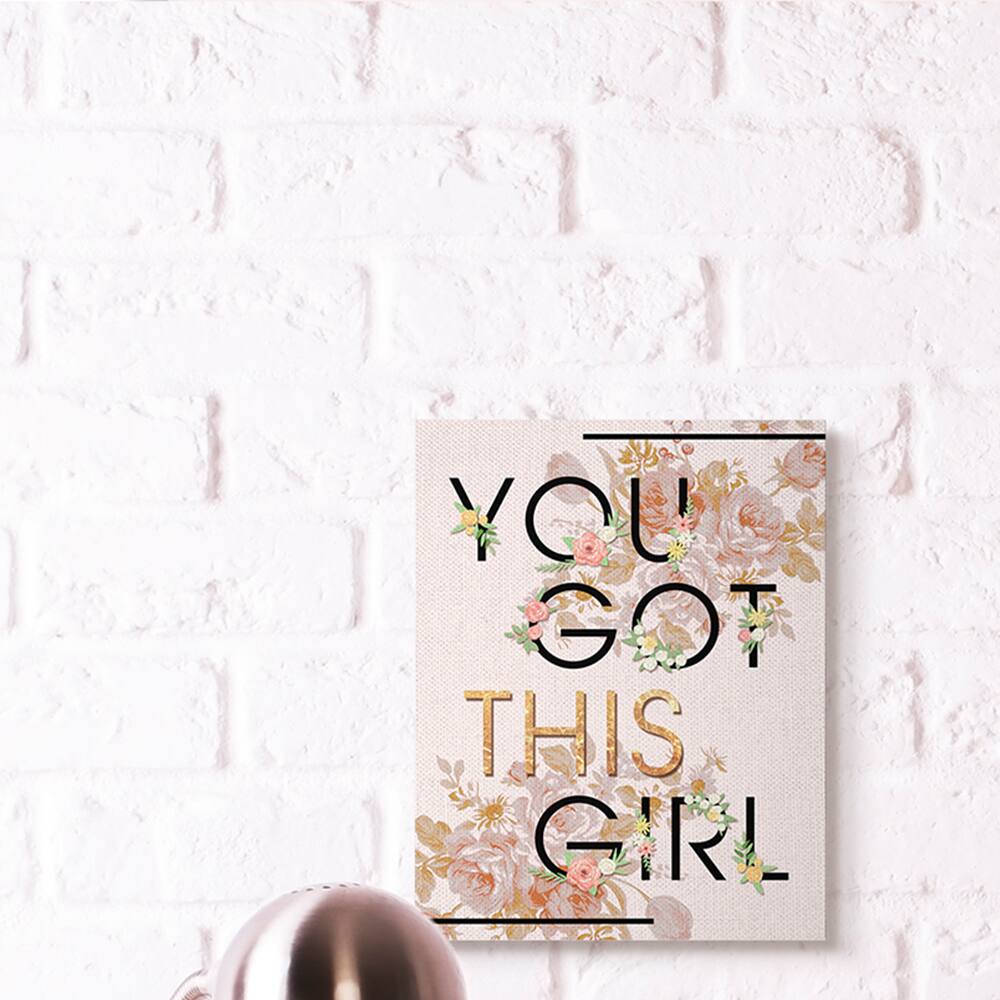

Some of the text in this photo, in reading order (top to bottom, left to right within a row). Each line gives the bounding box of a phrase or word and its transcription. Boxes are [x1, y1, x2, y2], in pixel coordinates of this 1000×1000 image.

[449, 476, 688, 563] YOU
[529, 583, 777, 668] GOT
[464, 688, 685, 777] THIS
[535, 795, 789, 881] GIRL
